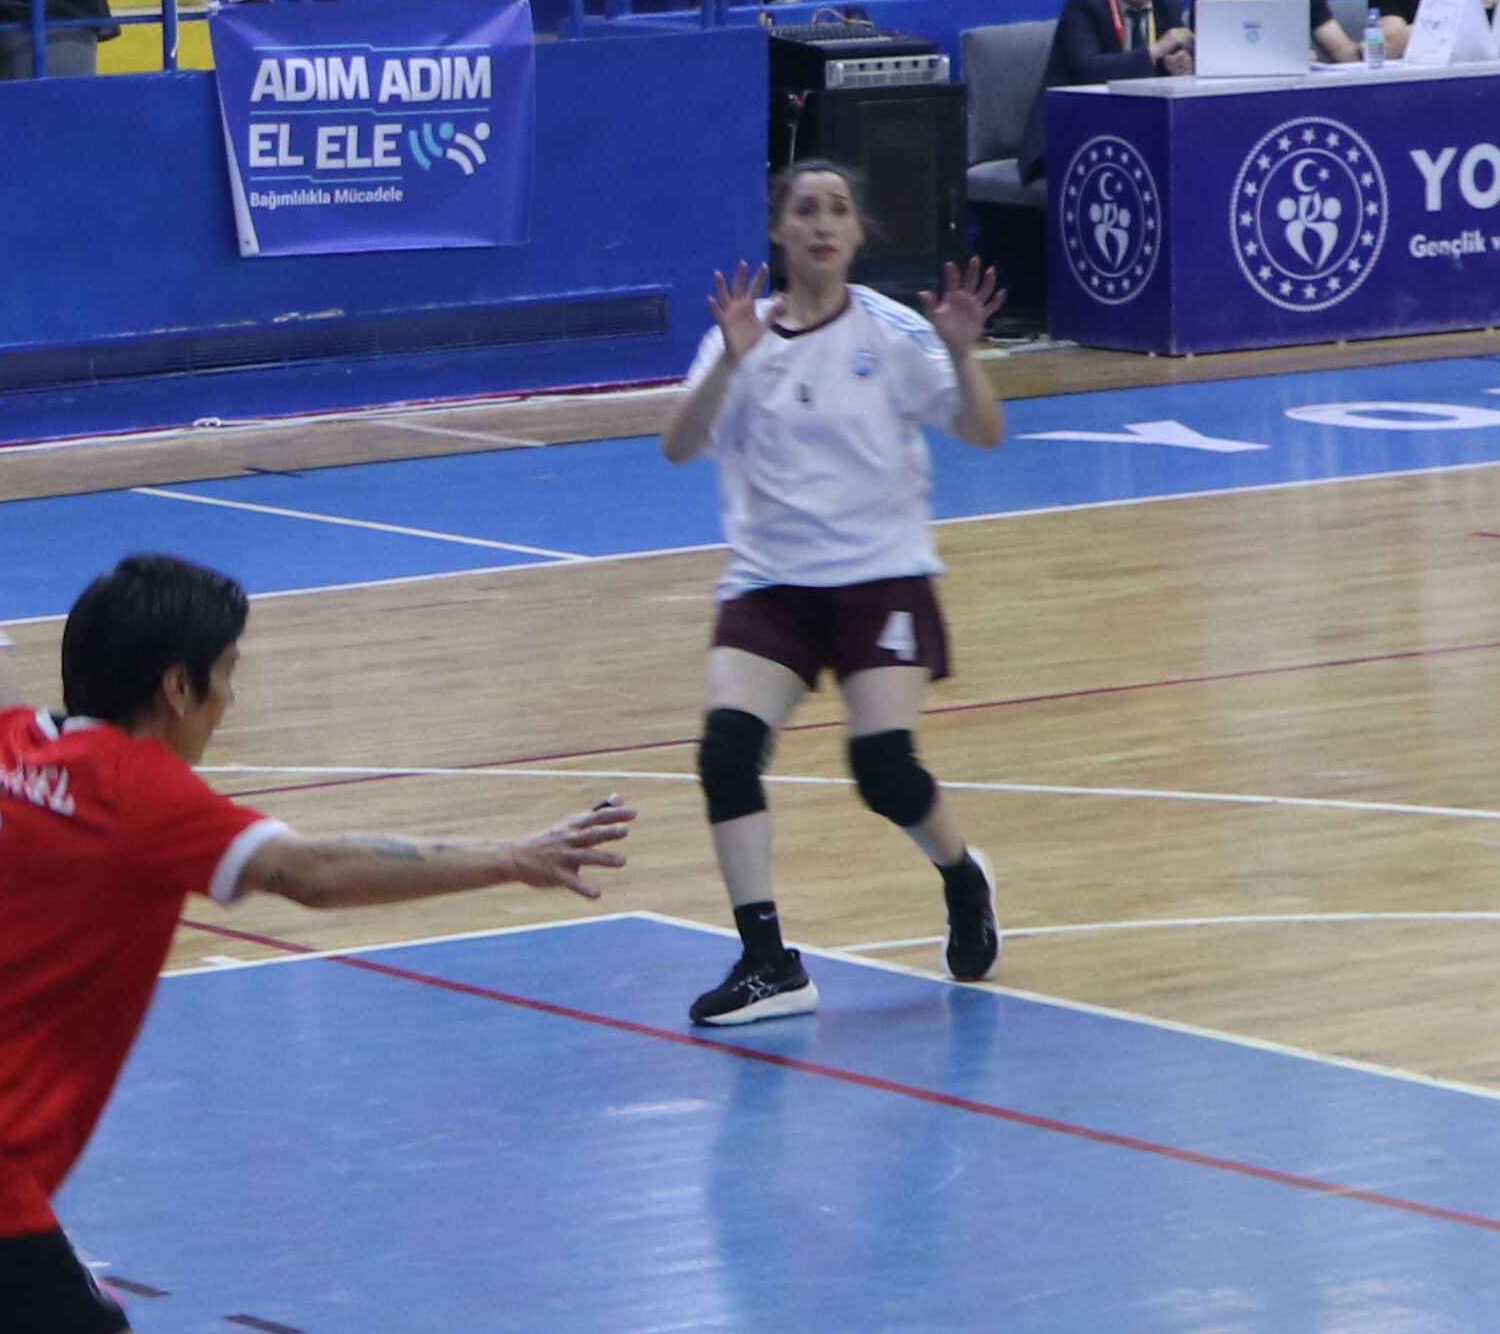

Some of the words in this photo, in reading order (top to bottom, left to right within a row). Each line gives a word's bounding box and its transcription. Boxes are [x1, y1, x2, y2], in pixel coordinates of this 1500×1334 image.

[250, 56, 370, 102] ADIM
[378, 55, 492, 102] ADIM
[249, 123, 304, 167] EL
[316, 123, 403, 169] ELE
[250, 188, 331, 210] Bağımlılıkla
[334, 186, 404, 204] Mücadele
[1408, 230, 1487, 261] Gençlik
[876, 610, 918, 661] 4
